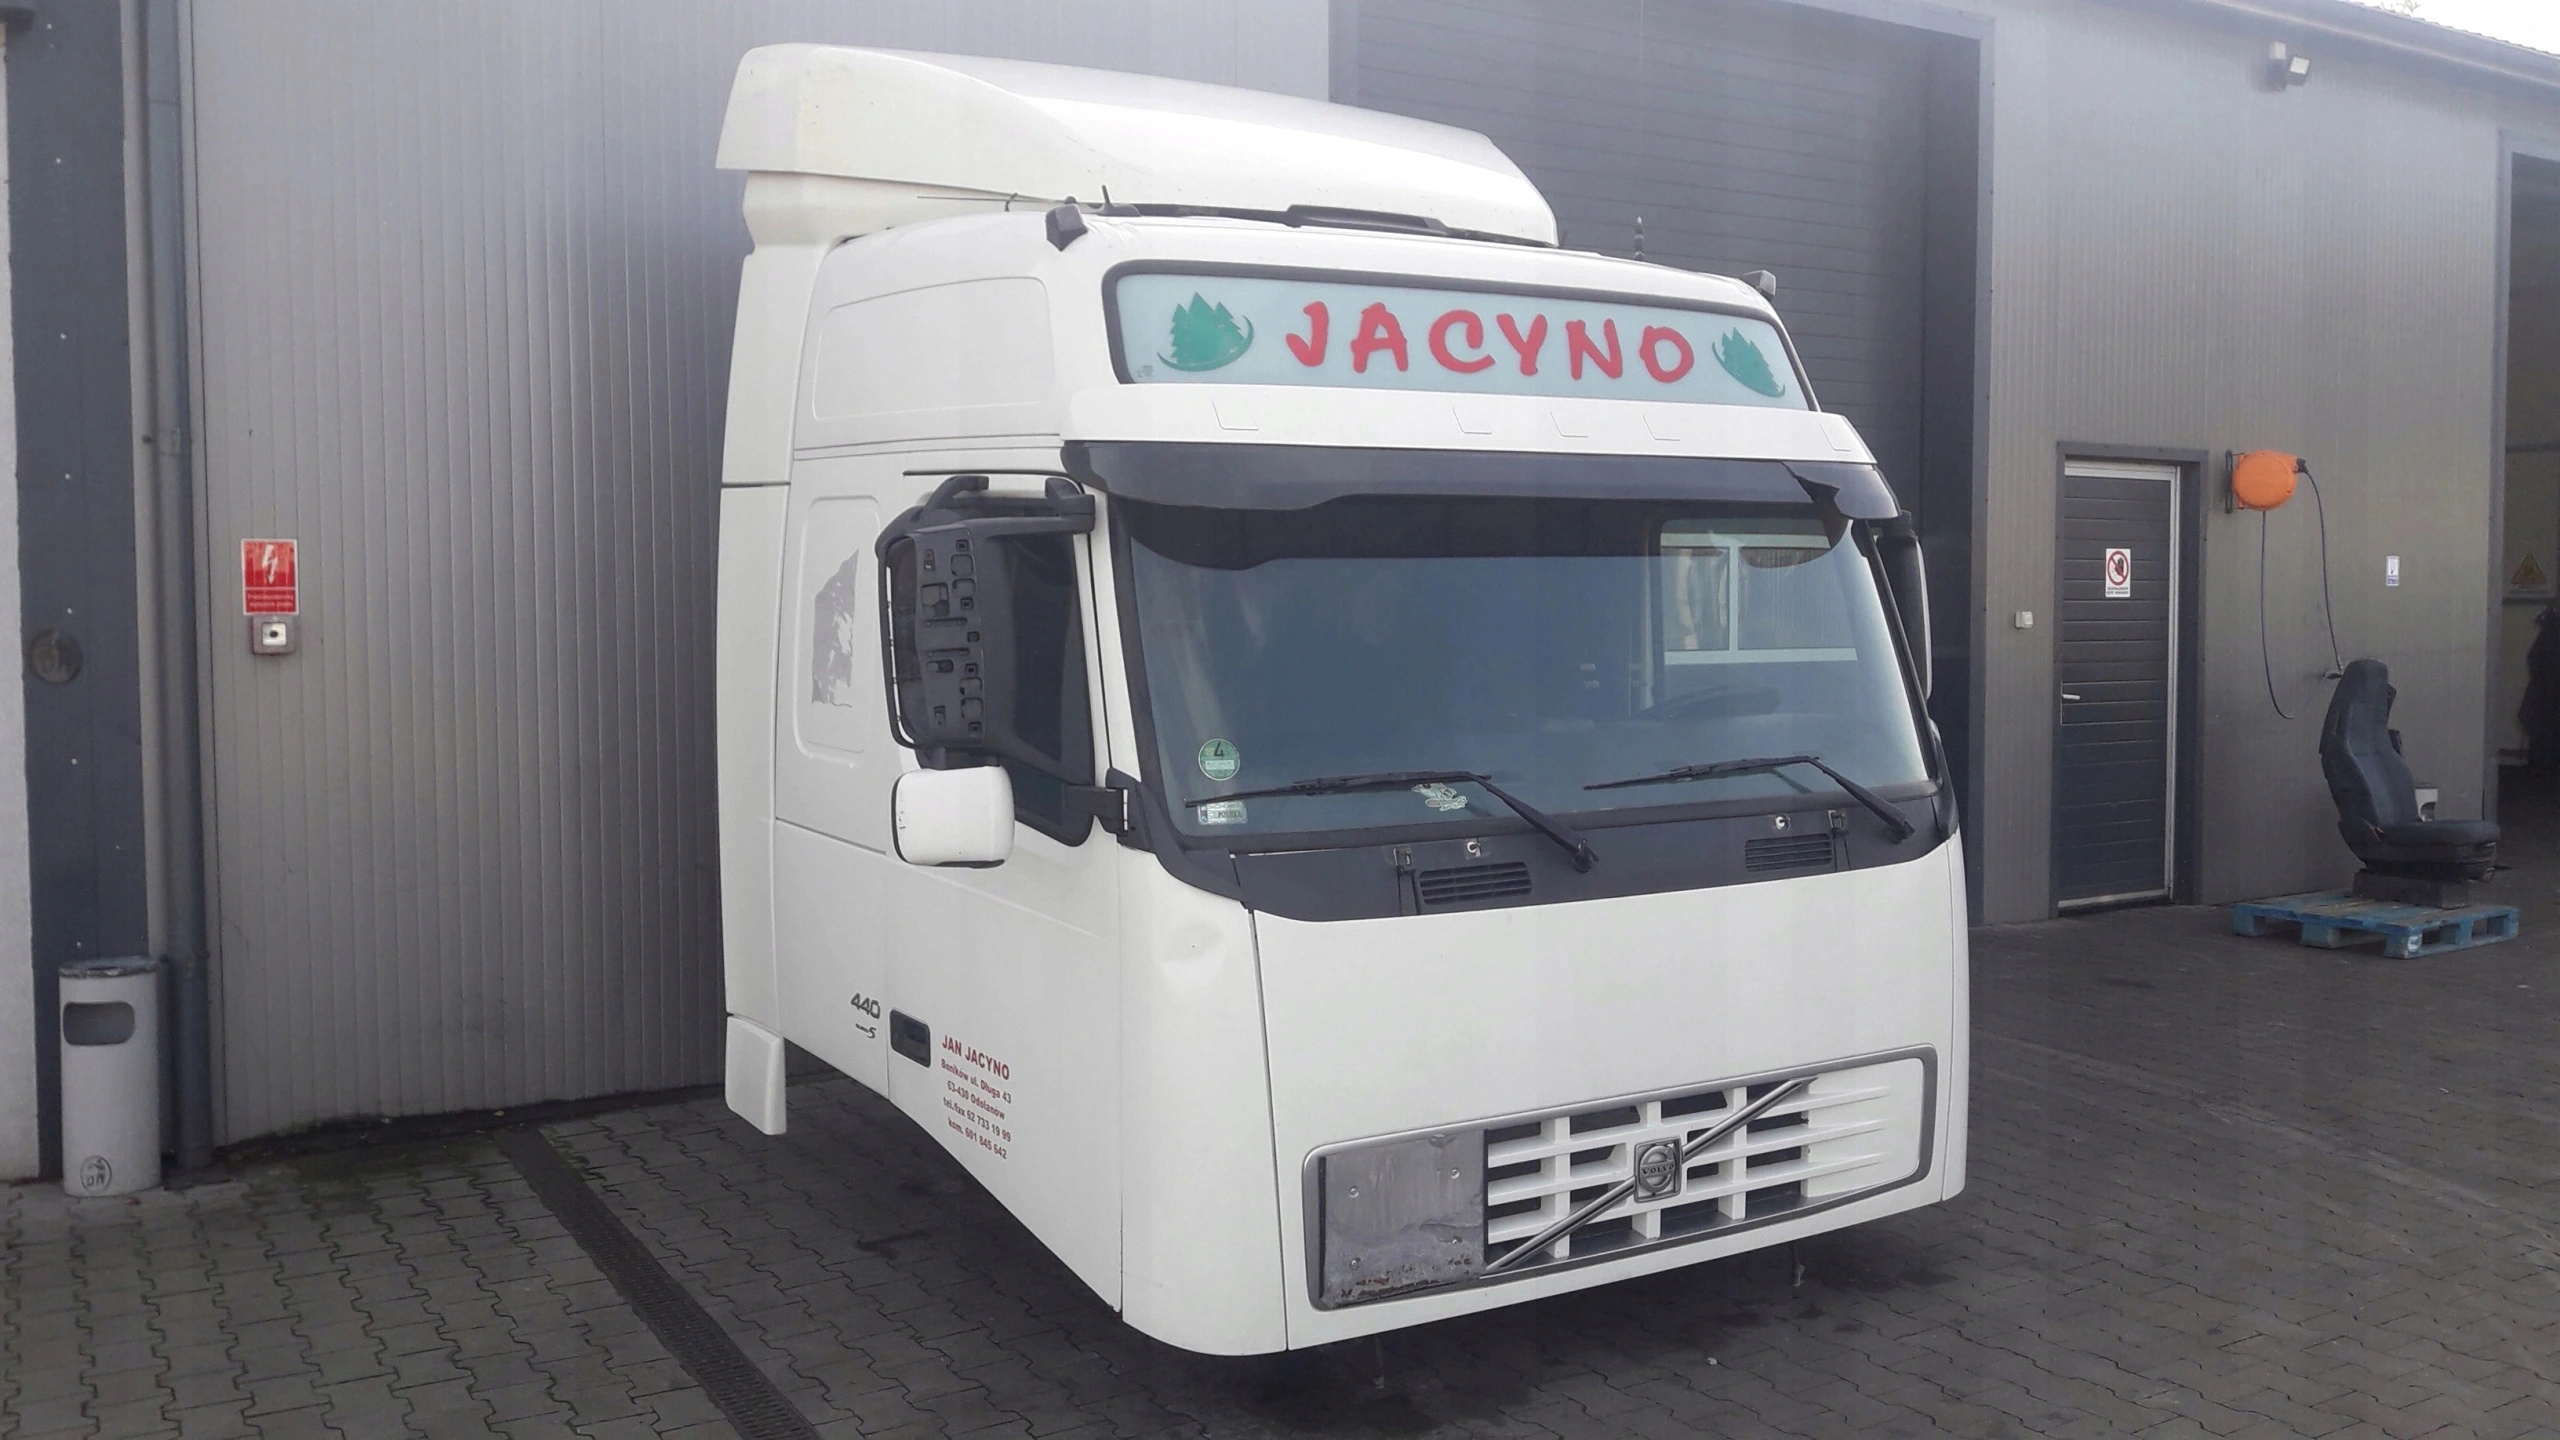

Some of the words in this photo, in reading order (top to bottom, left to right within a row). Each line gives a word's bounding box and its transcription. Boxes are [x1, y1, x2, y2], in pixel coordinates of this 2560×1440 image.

[1285, 301, 1695, 383] JACYNO
[1214, 741, 1225, 758] 4
[851, 993, 881, 1019] 440
[942, 1035, 962, 1056] JAN
[965, 1046, 1010, 1081] JACYNO
[1002, 1091, 1012, 1104] 43
[966, 1109, 976, 1123] 62
[977, 1115, 990, 1131] 733
[991, 1124, 1001, 1136] 19
[1001, 1129, 1011, 1142] 99
[1641, 1164, 1675, 1175] VOLVO
